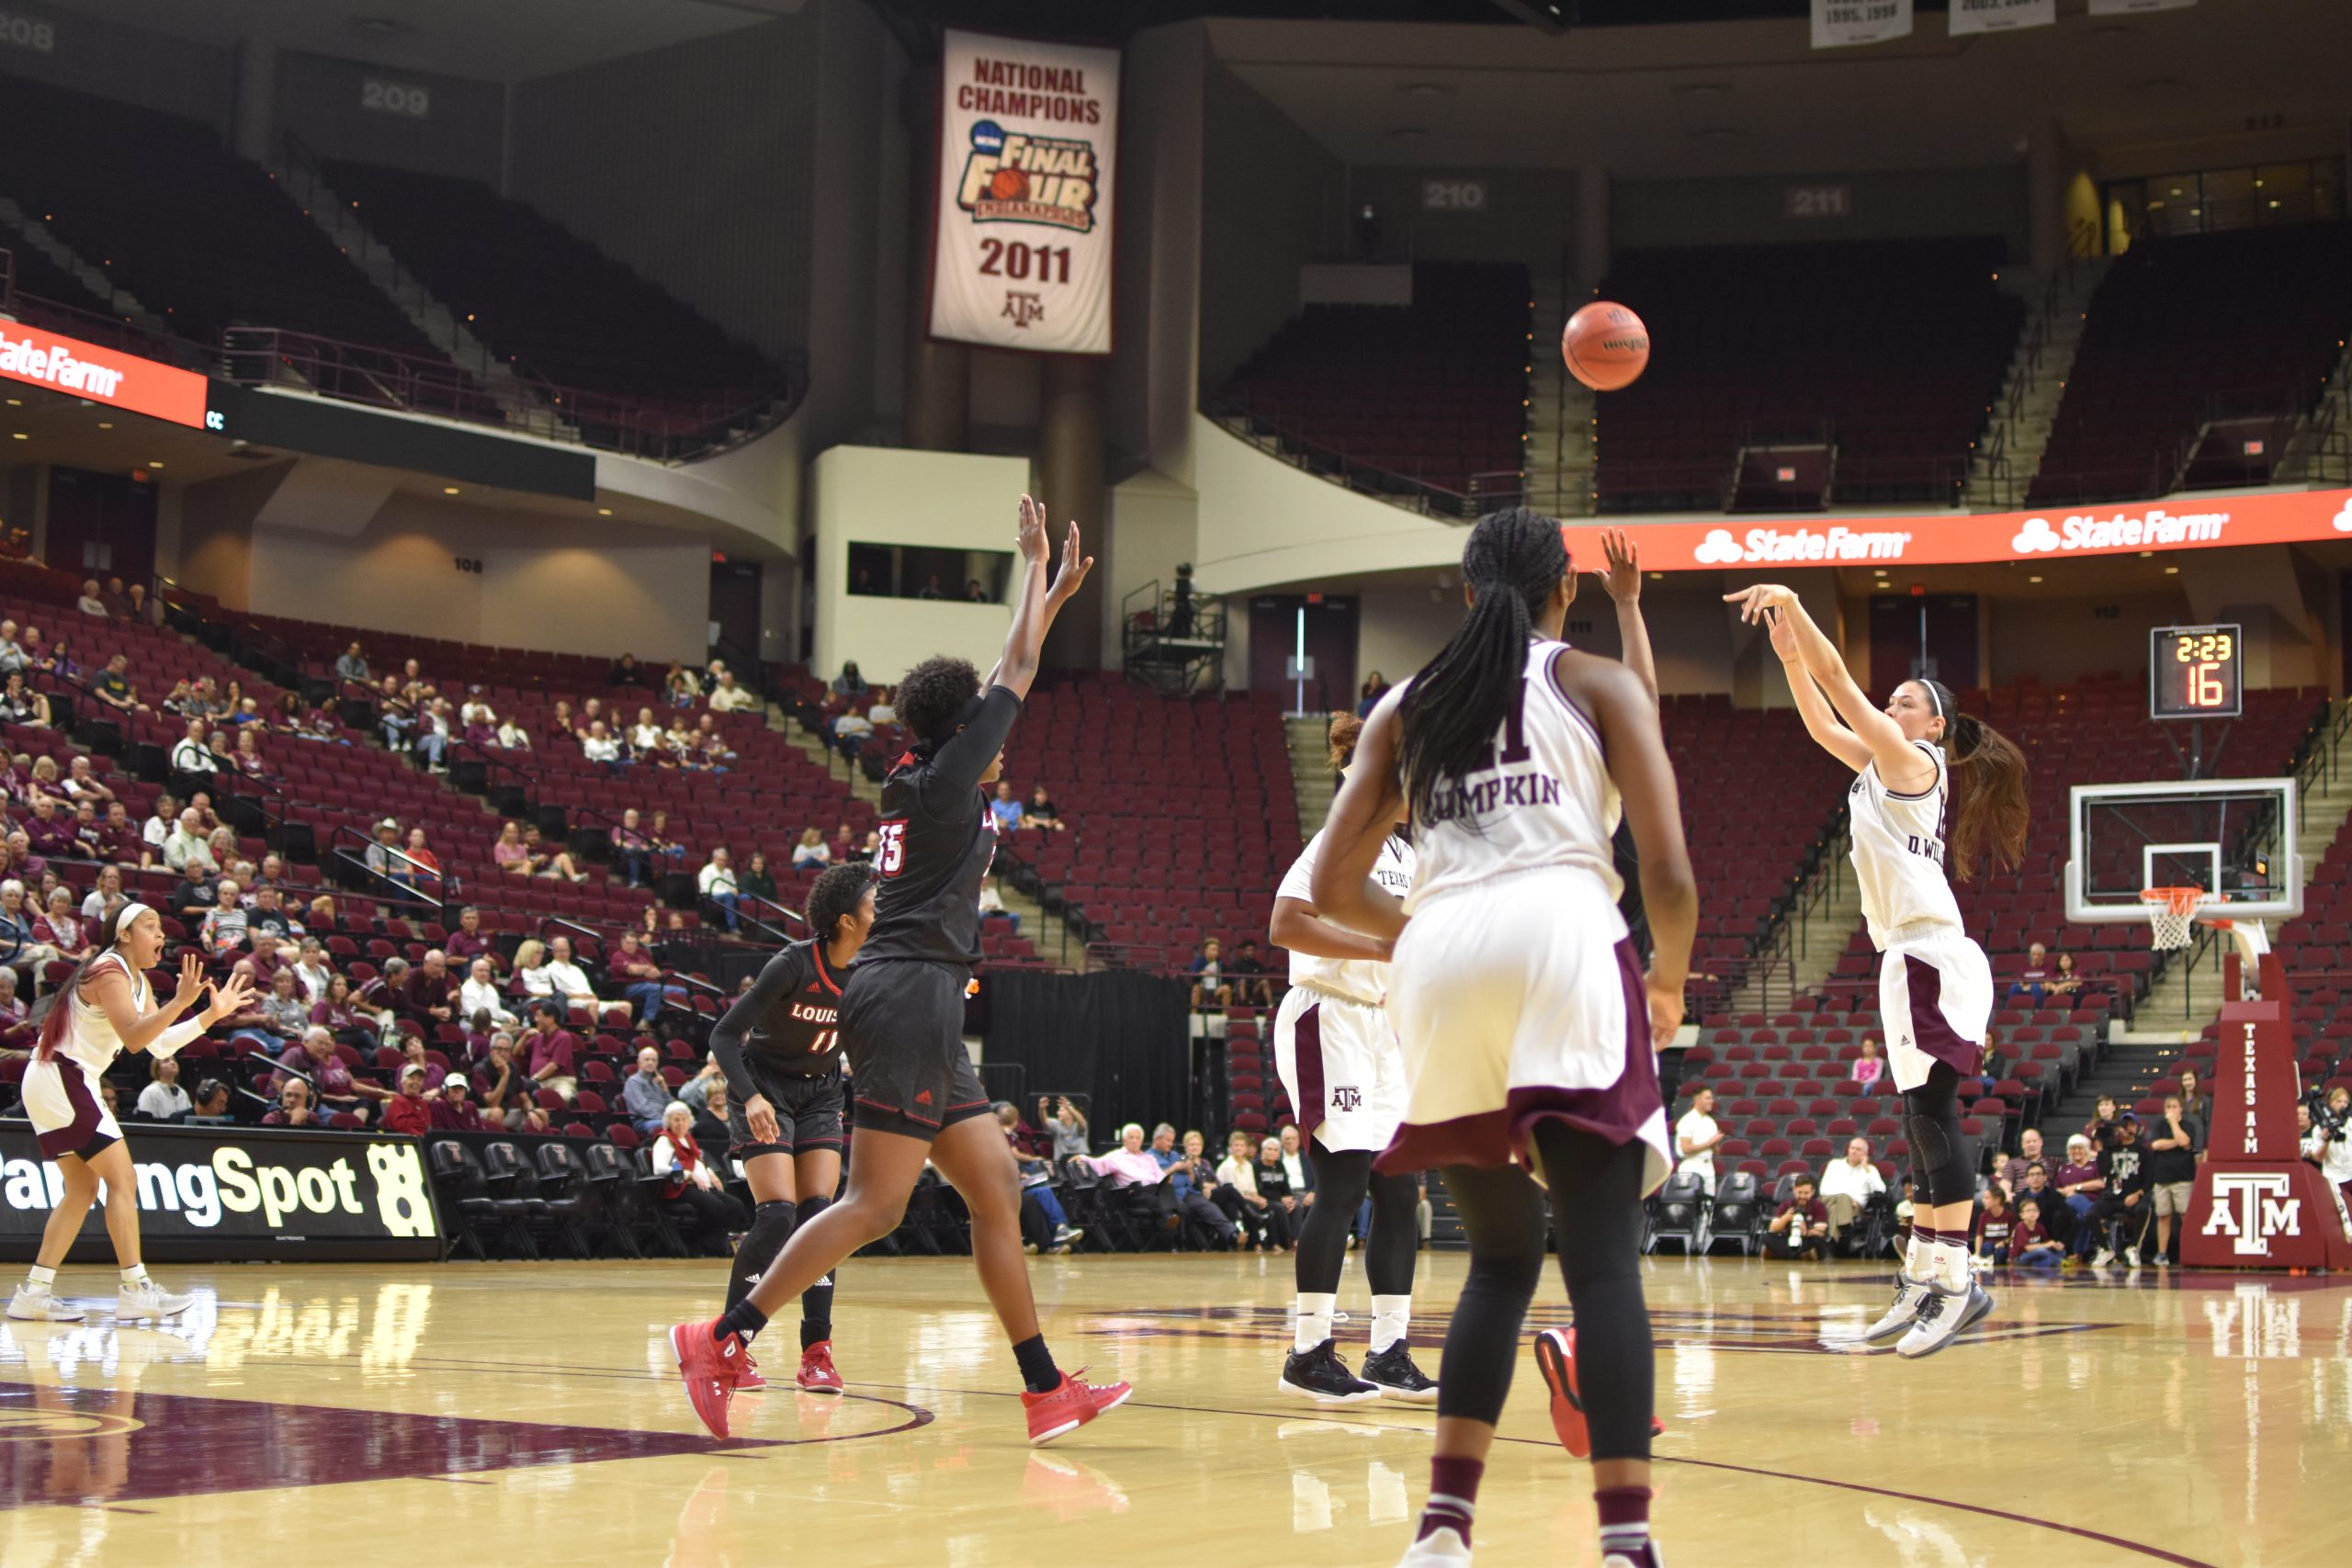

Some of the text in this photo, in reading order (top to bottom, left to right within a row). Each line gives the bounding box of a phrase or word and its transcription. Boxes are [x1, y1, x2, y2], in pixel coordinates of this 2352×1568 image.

[974, 58, 1087, 96] NATIONAL
[362, 82, 429, 115] 209
[957, 84, 1101, 125] CHAMPIONS
[1000, 134, 1093, 177] FINAL
[1427, 183, 1483, 208] 210
[1794, 190, 1842, 213] 211
[978, 237, 1070, 284] 2011
[455, 557, 483, 574] 108
[2177, 635, 2232, 662] 2:23
[2188, 662, 2222, 706] 16
[1422, 773, 1561, 827] UMPKIN
[1907, 834, 1921, 855] D.
[1376, 870, 1409, 889] TEXAS
[2243, 1022, 2256, 1106] TEXAS
[2202, 1172, 2301, 1255] ATM
